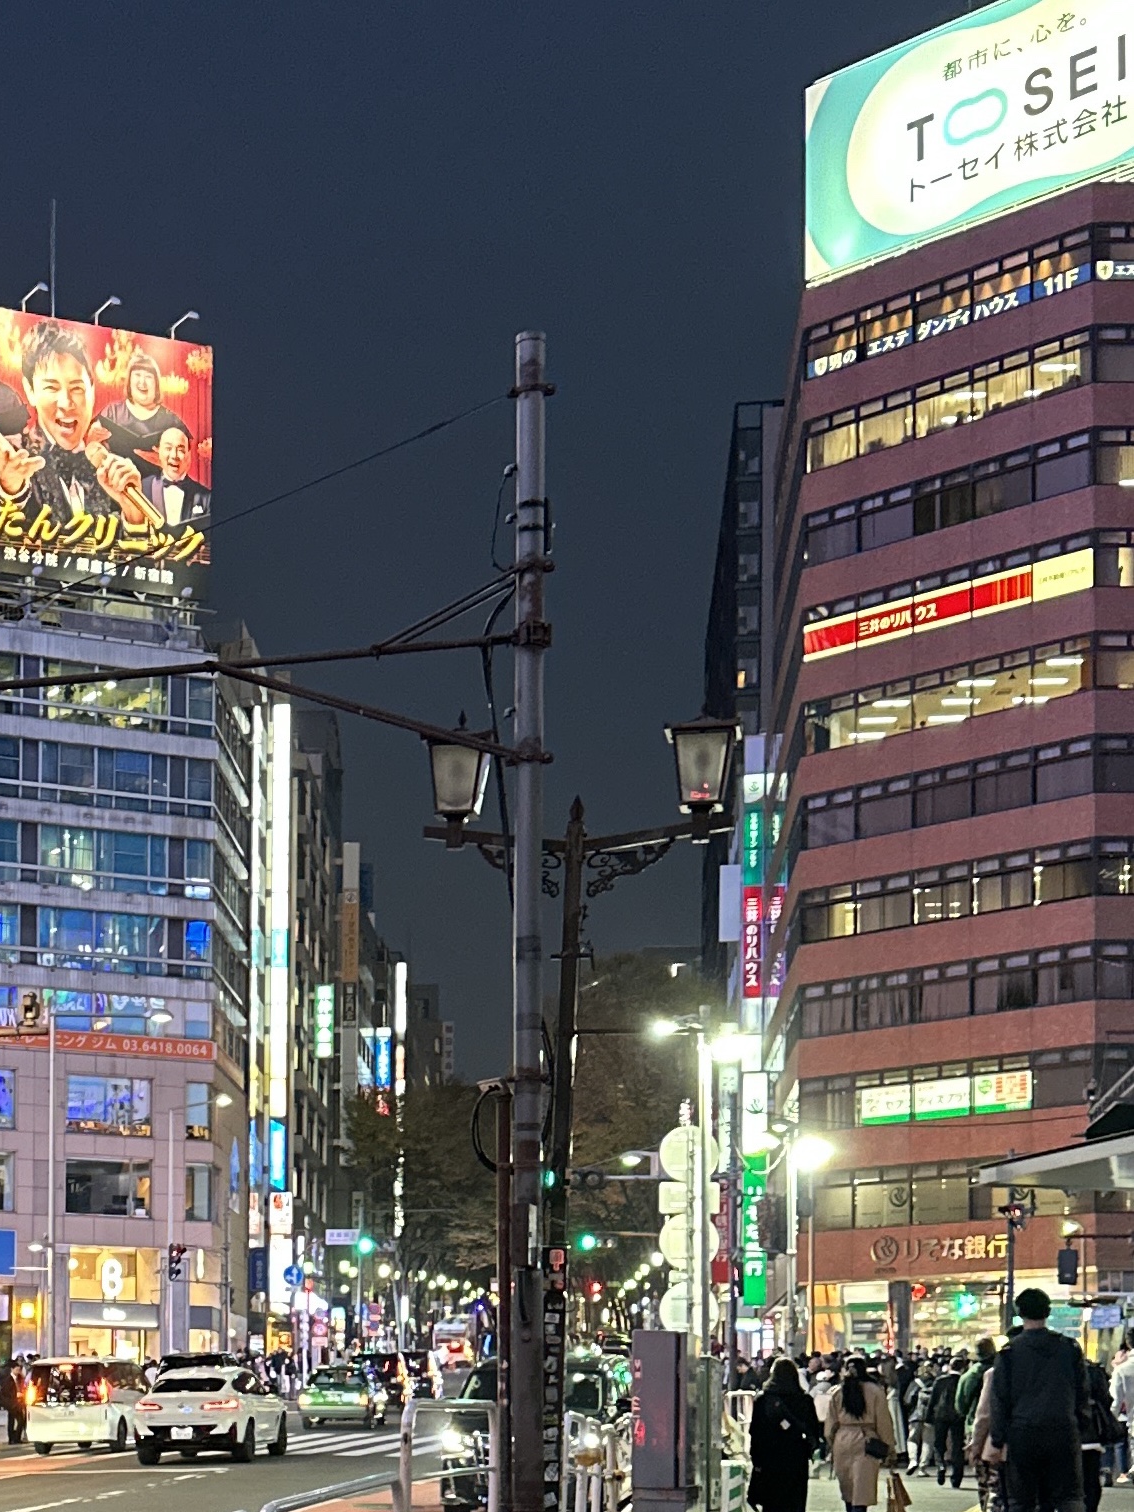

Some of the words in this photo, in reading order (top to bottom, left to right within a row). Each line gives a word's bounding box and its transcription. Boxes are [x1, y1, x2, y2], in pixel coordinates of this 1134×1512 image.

[942, 13, 1087, 82] 都市に、心を。
[909, 95, 1127, 203] トーセイ株式会社
[1043, 267, 1080, 297] 11F
[858, 602, 938, 637] 三井のリハウス
[745, 897, 760, 987] 三井のリハウス
[122, 1039, 209, 1057] 03.6418.0064
[903, 1233, 1009, 1264] りそな銀行
